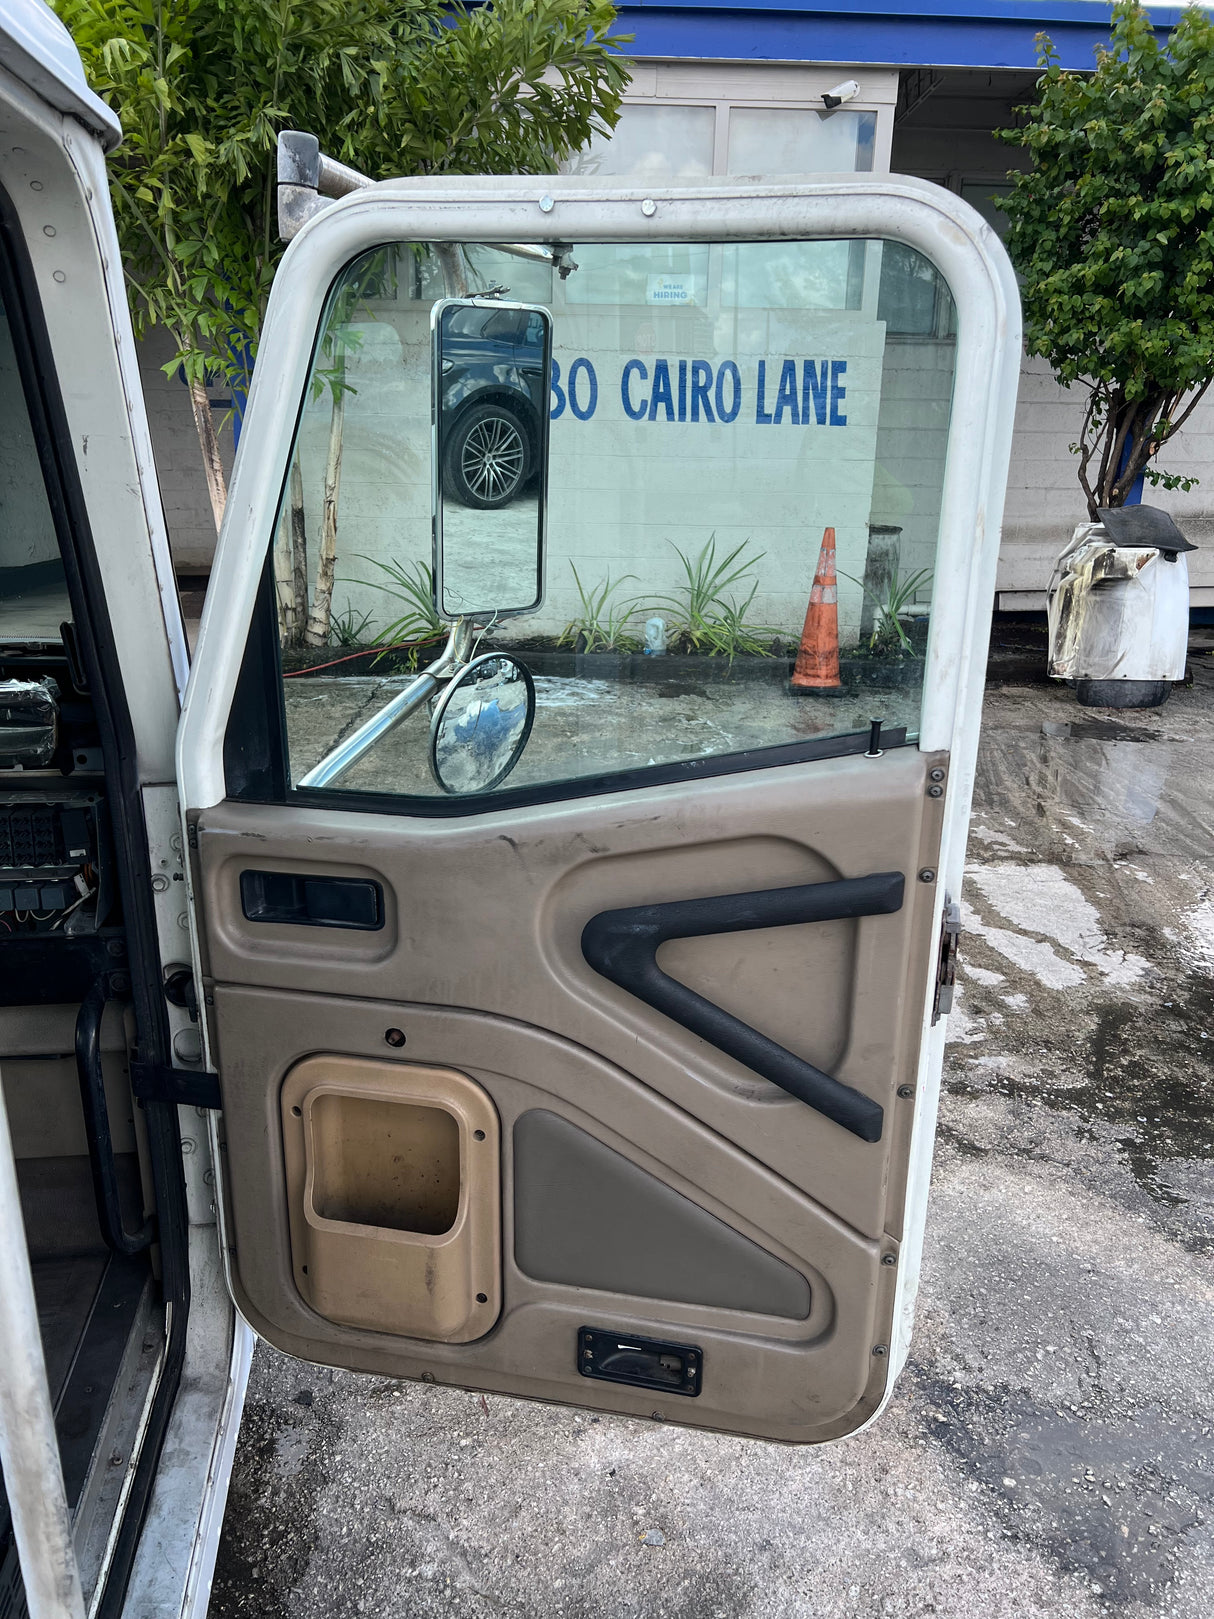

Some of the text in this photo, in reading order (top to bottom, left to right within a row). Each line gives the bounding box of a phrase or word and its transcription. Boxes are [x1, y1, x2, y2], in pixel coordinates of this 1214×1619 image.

[653, 291, 688, 299] HIRING
[621, 358, 741, 423] CAIRO
[756, 360, 847, 426] LANE
